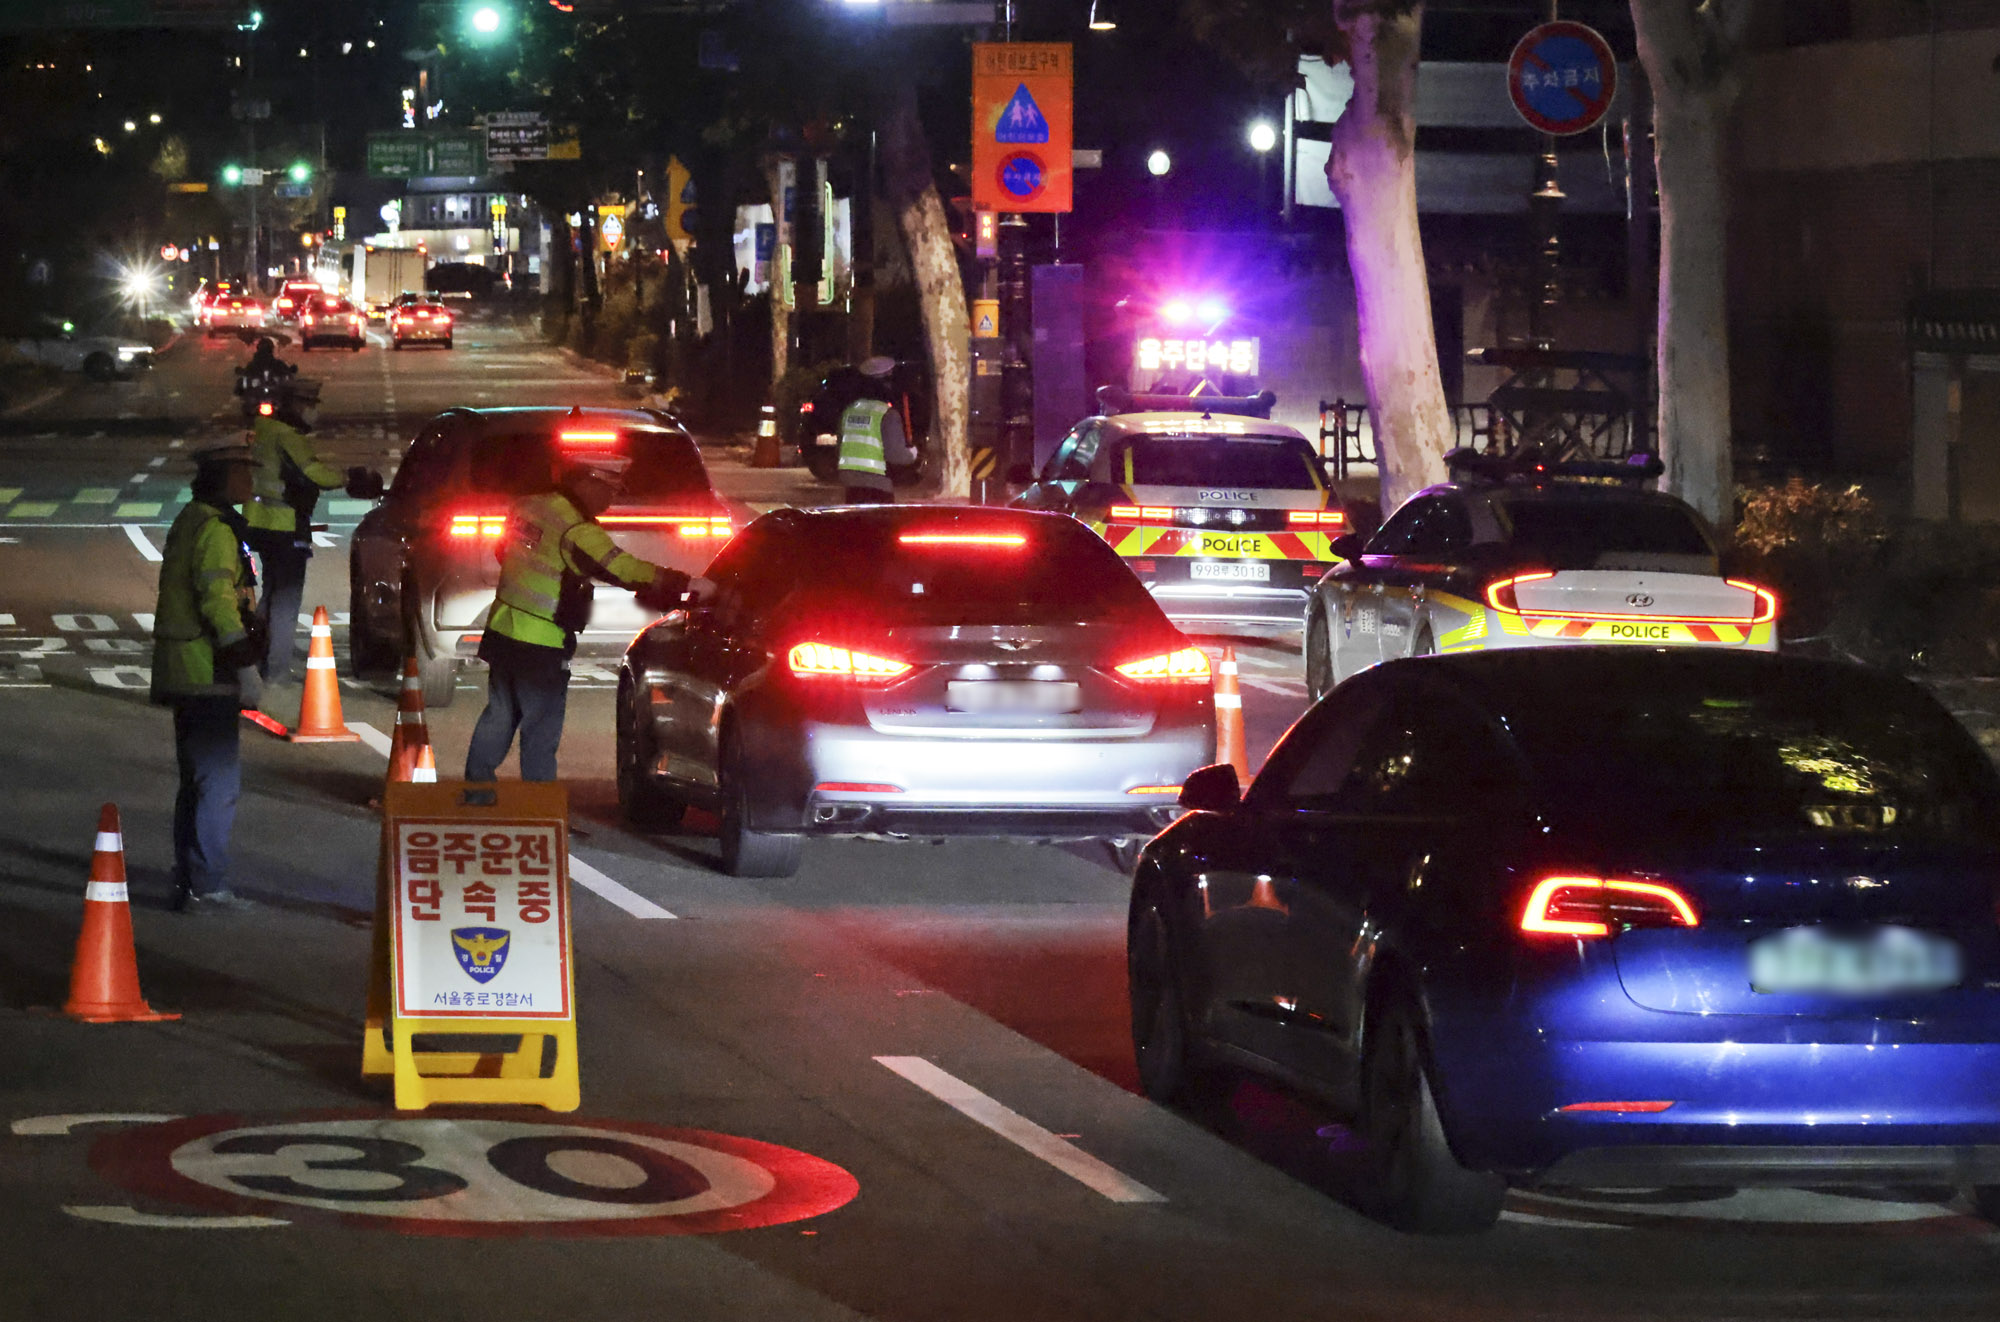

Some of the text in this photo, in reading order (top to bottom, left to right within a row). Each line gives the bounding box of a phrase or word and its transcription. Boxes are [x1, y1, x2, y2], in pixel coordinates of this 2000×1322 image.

[1522, 66, 1600, 91] 주차금지
[1139, 338, 1253, 373] 음주단속중
[1199, 489, 1259, 502] POLICE
[1203, 538, 1261, 552] POLICE
[1232, 565, 1265, 578] 3018
[1611, 624, 1670, 639] POLICE
[406, 831, 550, 875] 음주운전
[469, 966, 495, 974] POLICE
[433, 990, 533, 1007] 서울종로경찰서
[210, 1133, 712, 1204] 30
